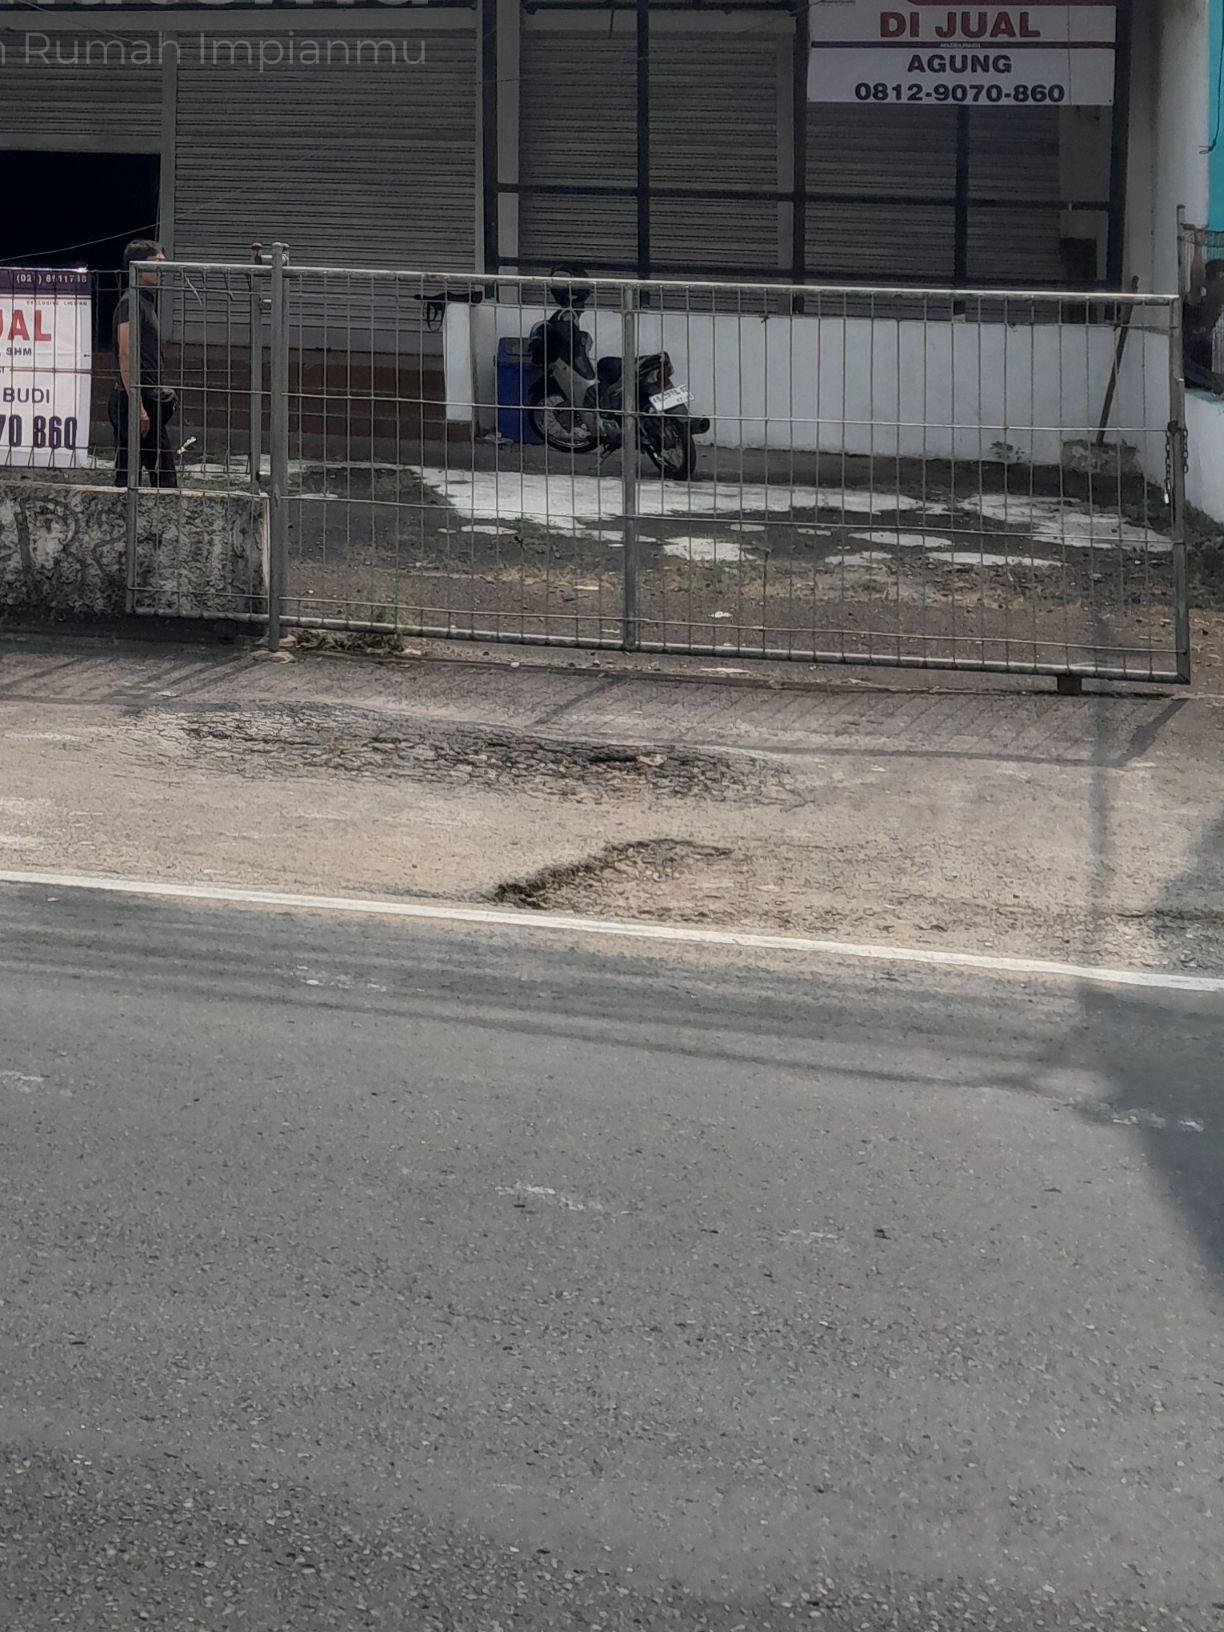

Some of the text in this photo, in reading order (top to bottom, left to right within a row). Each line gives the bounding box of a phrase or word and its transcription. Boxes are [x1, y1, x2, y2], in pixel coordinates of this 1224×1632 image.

[880, 10, 1041, 38] DI JUAL
[907, 54, 1013, 73] AGUNG
[855, 83, 1066, 103] 0812-9070-860
[16, 273, 42, 286] (02)
[6, 346, 32, 356] SHM
[2, 387, 50, 404] BUDI
[32, 415, 78, 450] 860
